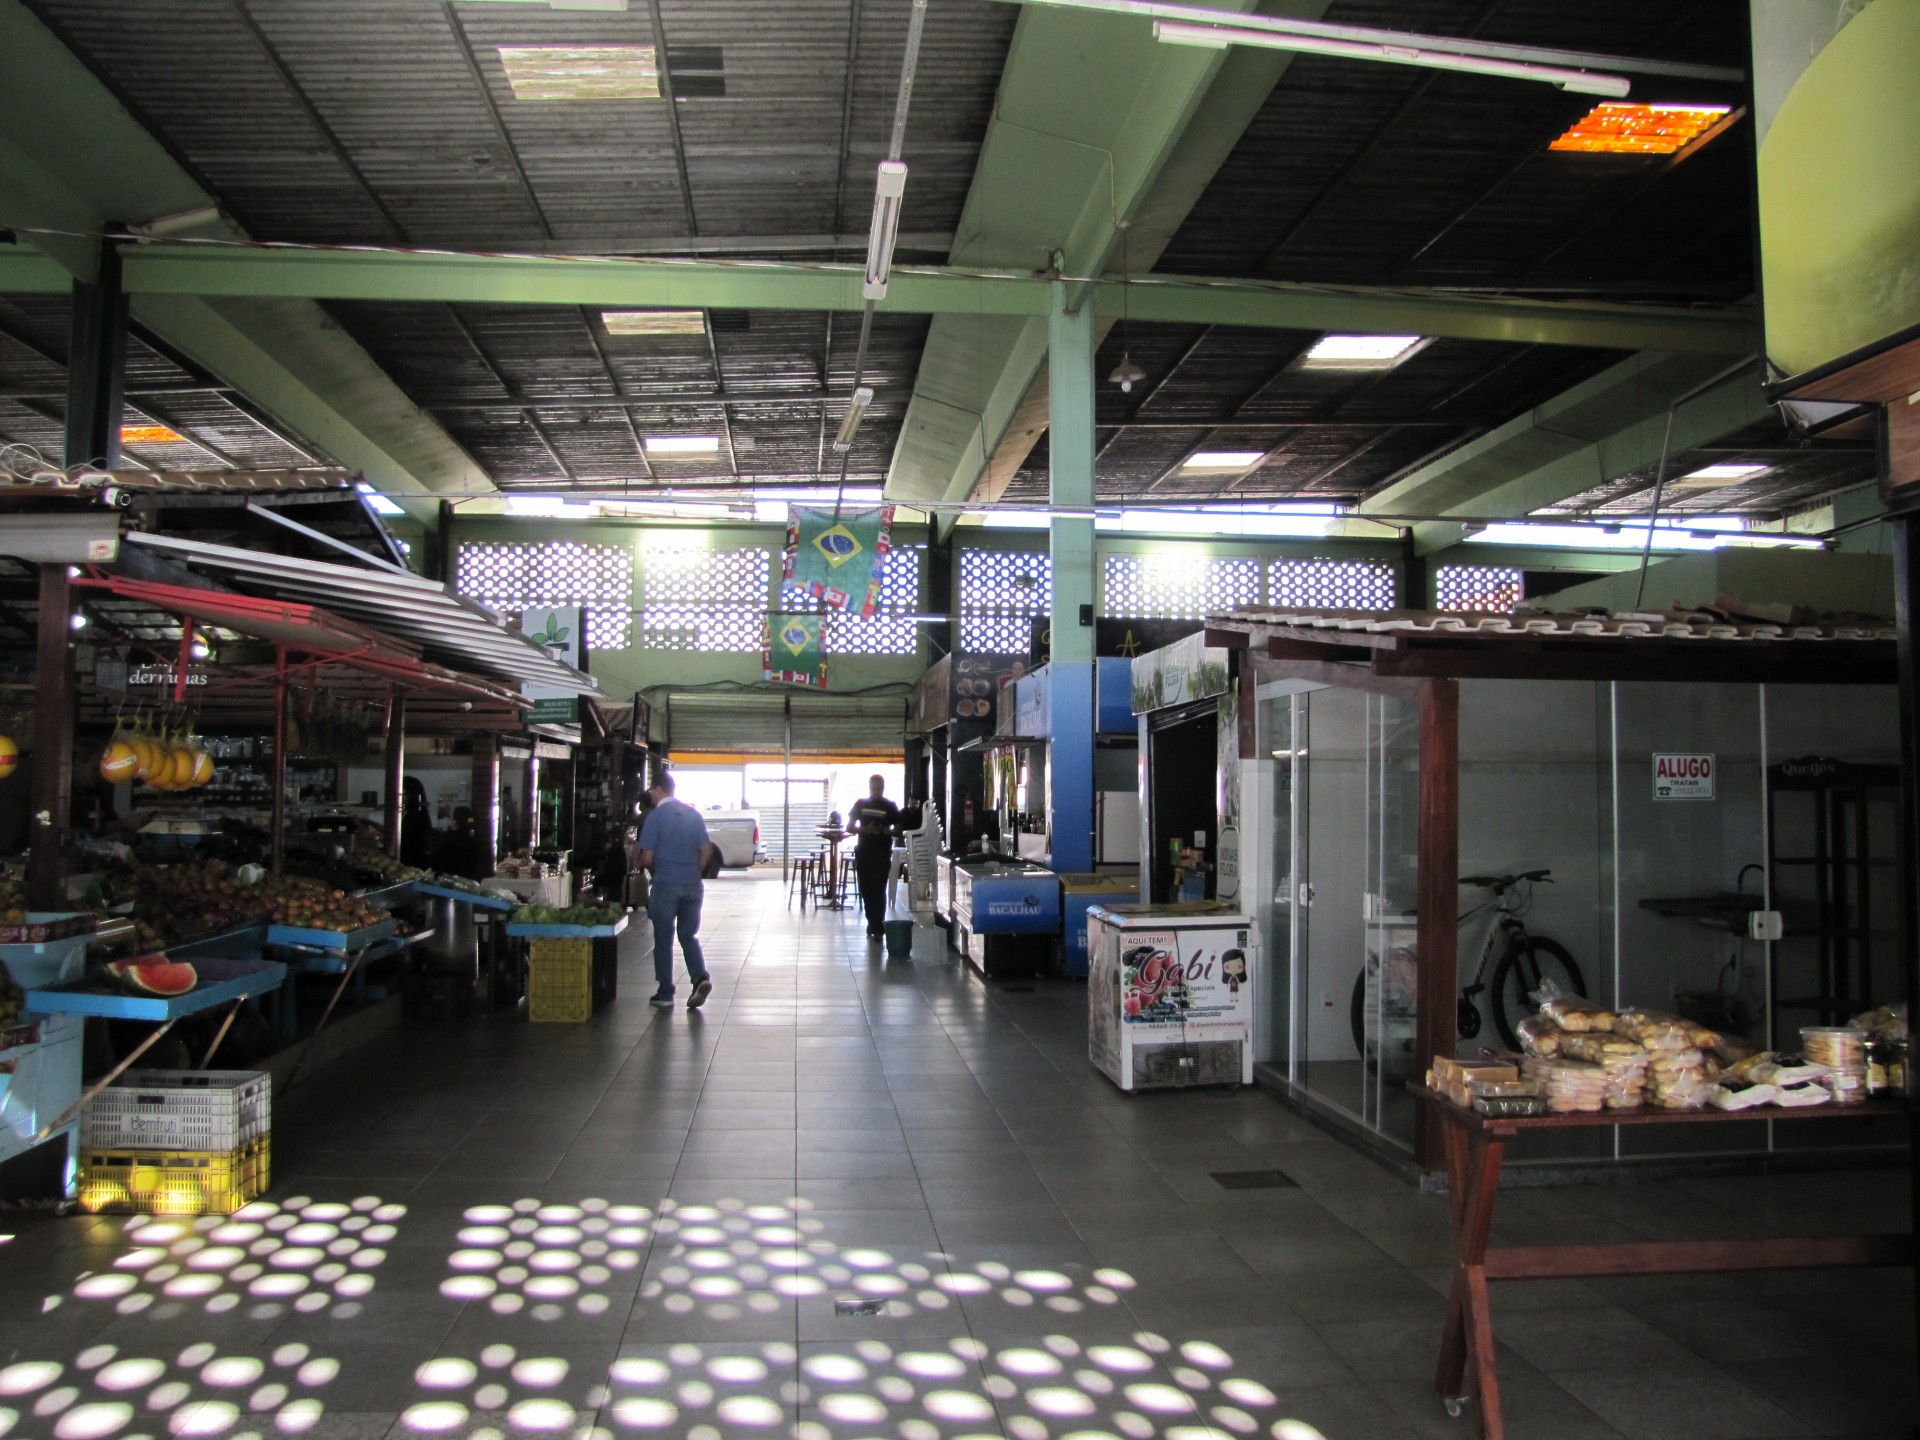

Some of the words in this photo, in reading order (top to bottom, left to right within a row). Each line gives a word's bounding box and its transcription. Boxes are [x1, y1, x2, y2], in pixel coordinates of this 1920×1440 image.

[1657, 757, 1711, 778] ALUGO
[1781, 762, 1835, 777] Queijos
[1220, 847, 1238, 862] MINAS
[1220, 862, 1238, 878] FLORA
[988, 906, 1042, 916] BACALHAU
[1127, 937, 1147, 945] AQUI
[1148, 936, 1166, 944] TEM!
[1129, 949, 1217, 996] Gabi
[1186, 984, 1216, 993] Especiais
